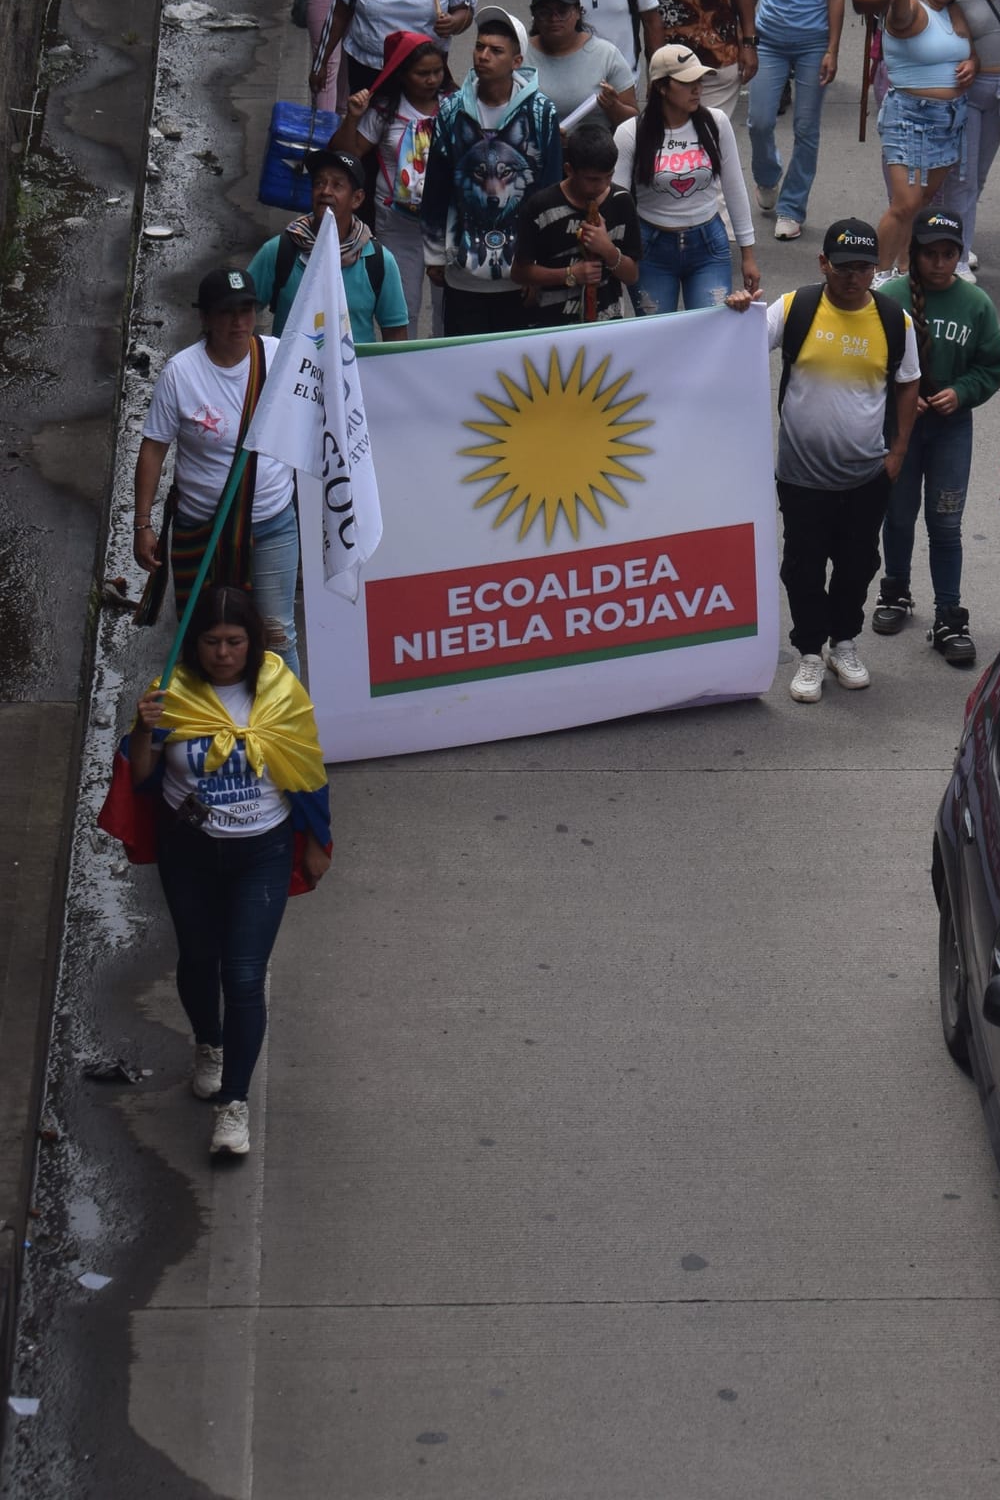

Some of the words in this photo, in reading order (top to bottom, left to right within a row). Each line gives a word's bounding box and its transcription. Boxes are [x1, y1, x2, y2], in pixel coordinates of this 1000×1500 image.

[843, 235, 876, 248] PUPSOC
[815, 329, 836, 342] DO
[840, 335, 870, 347] ONE
[924, 318, 972, 347] TON
[447, 553, 679, 617] ECOALDEA
[393, 613, 553, 665] NIEBLA
[564, 583, 735, 637] ROJAVA
[197, 774, 252, 794] CONTRA
[228, 801, 260, 815] SOMOS
